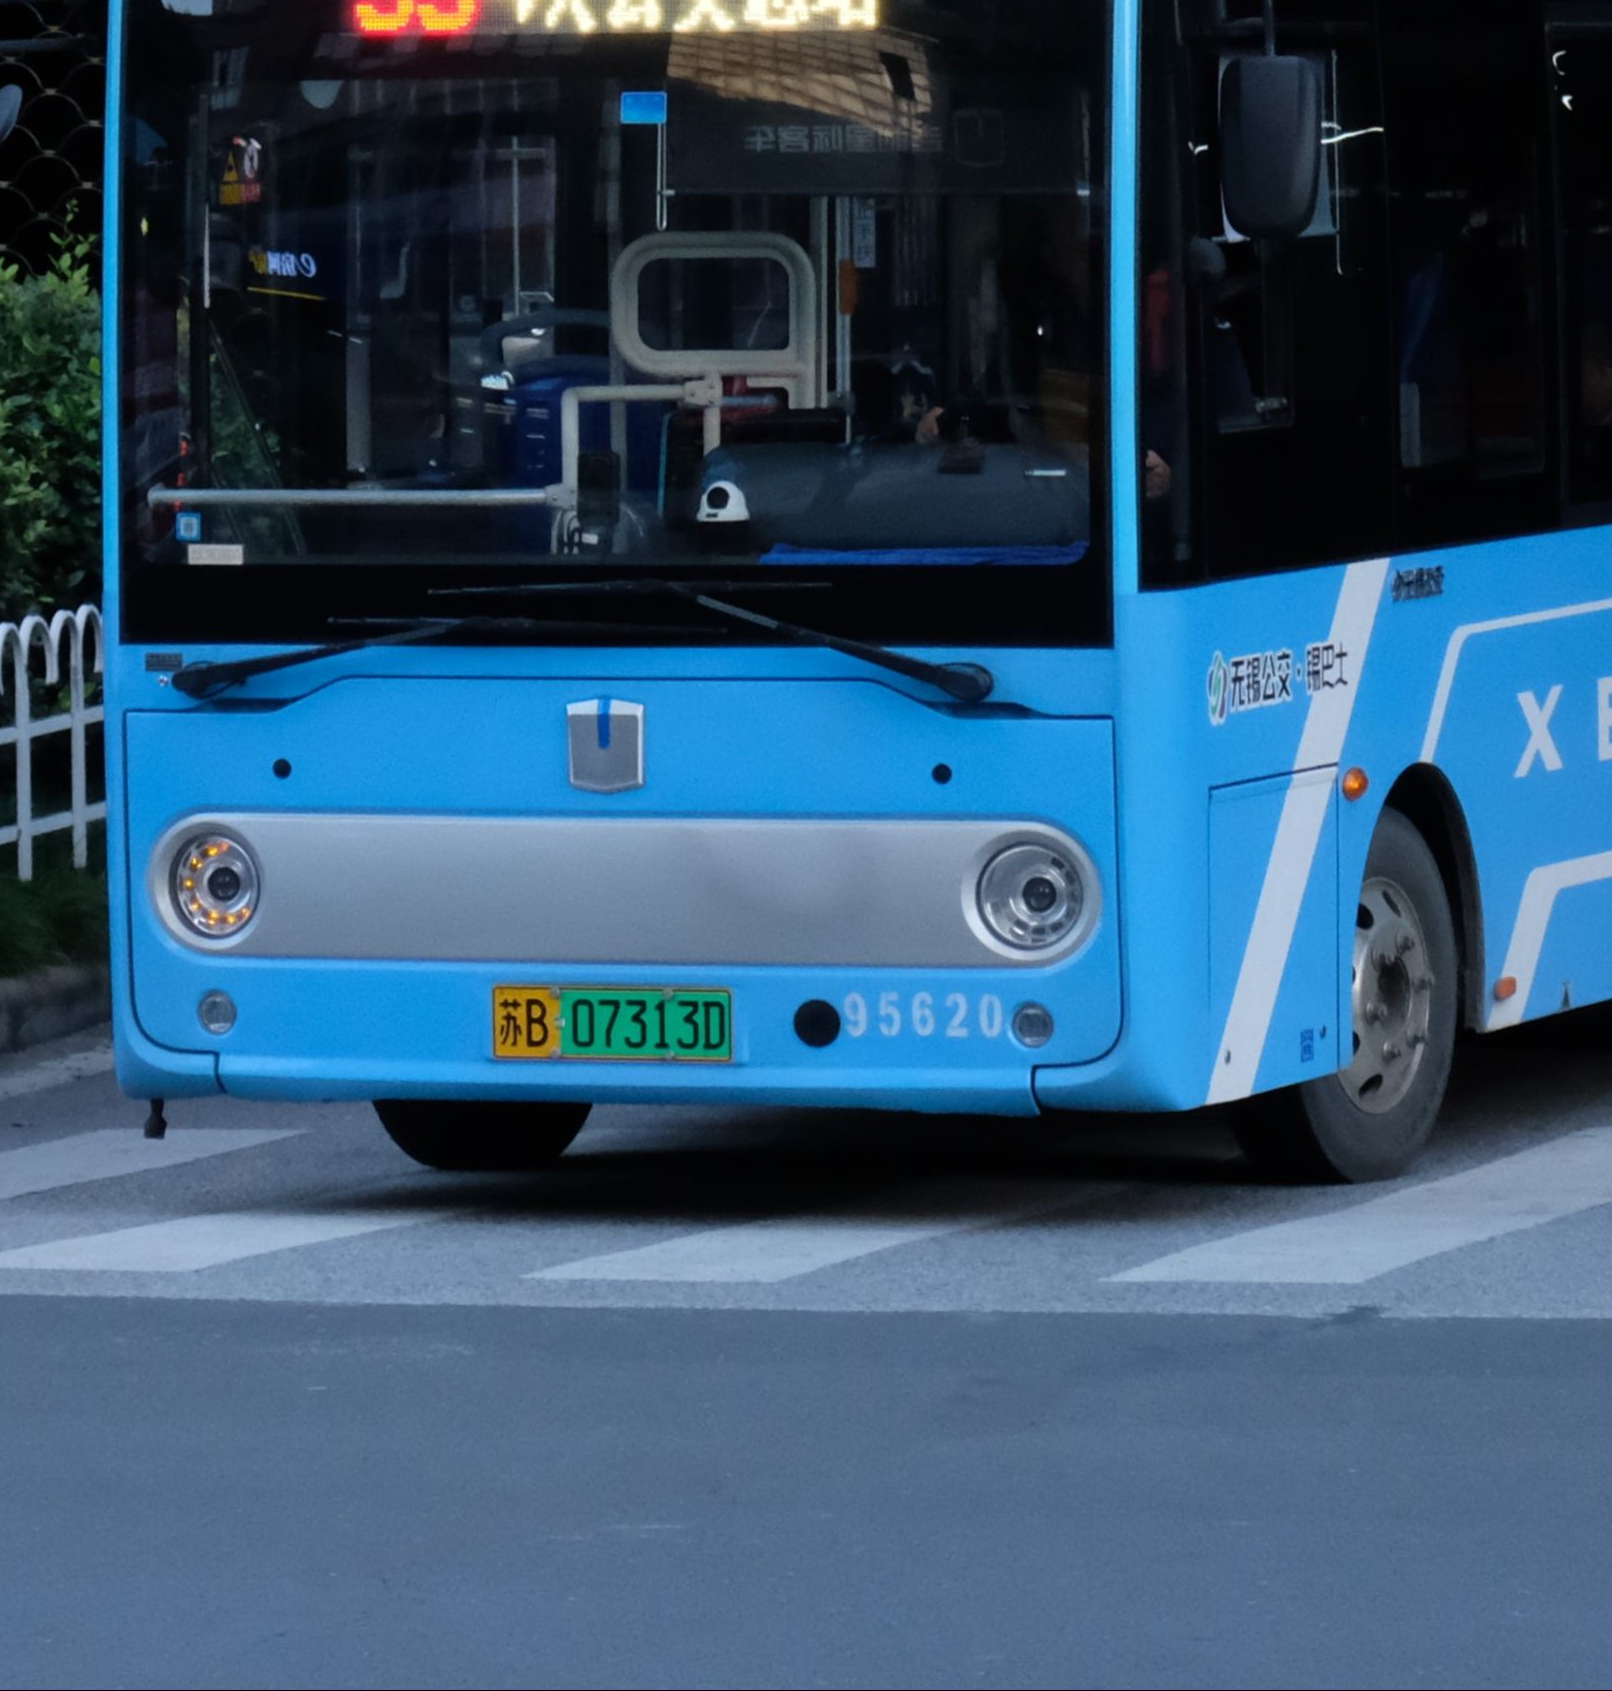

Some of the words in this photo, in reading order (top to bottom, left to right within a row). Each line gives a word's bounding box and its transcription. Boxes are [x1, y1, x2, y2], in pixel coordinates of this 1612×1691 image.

[1231, 642, 1348, 708] 无锡公交·锡巴士
[499, 997, 551, 1046] 苏B
[844, 991, 1004, 1040] 95620
